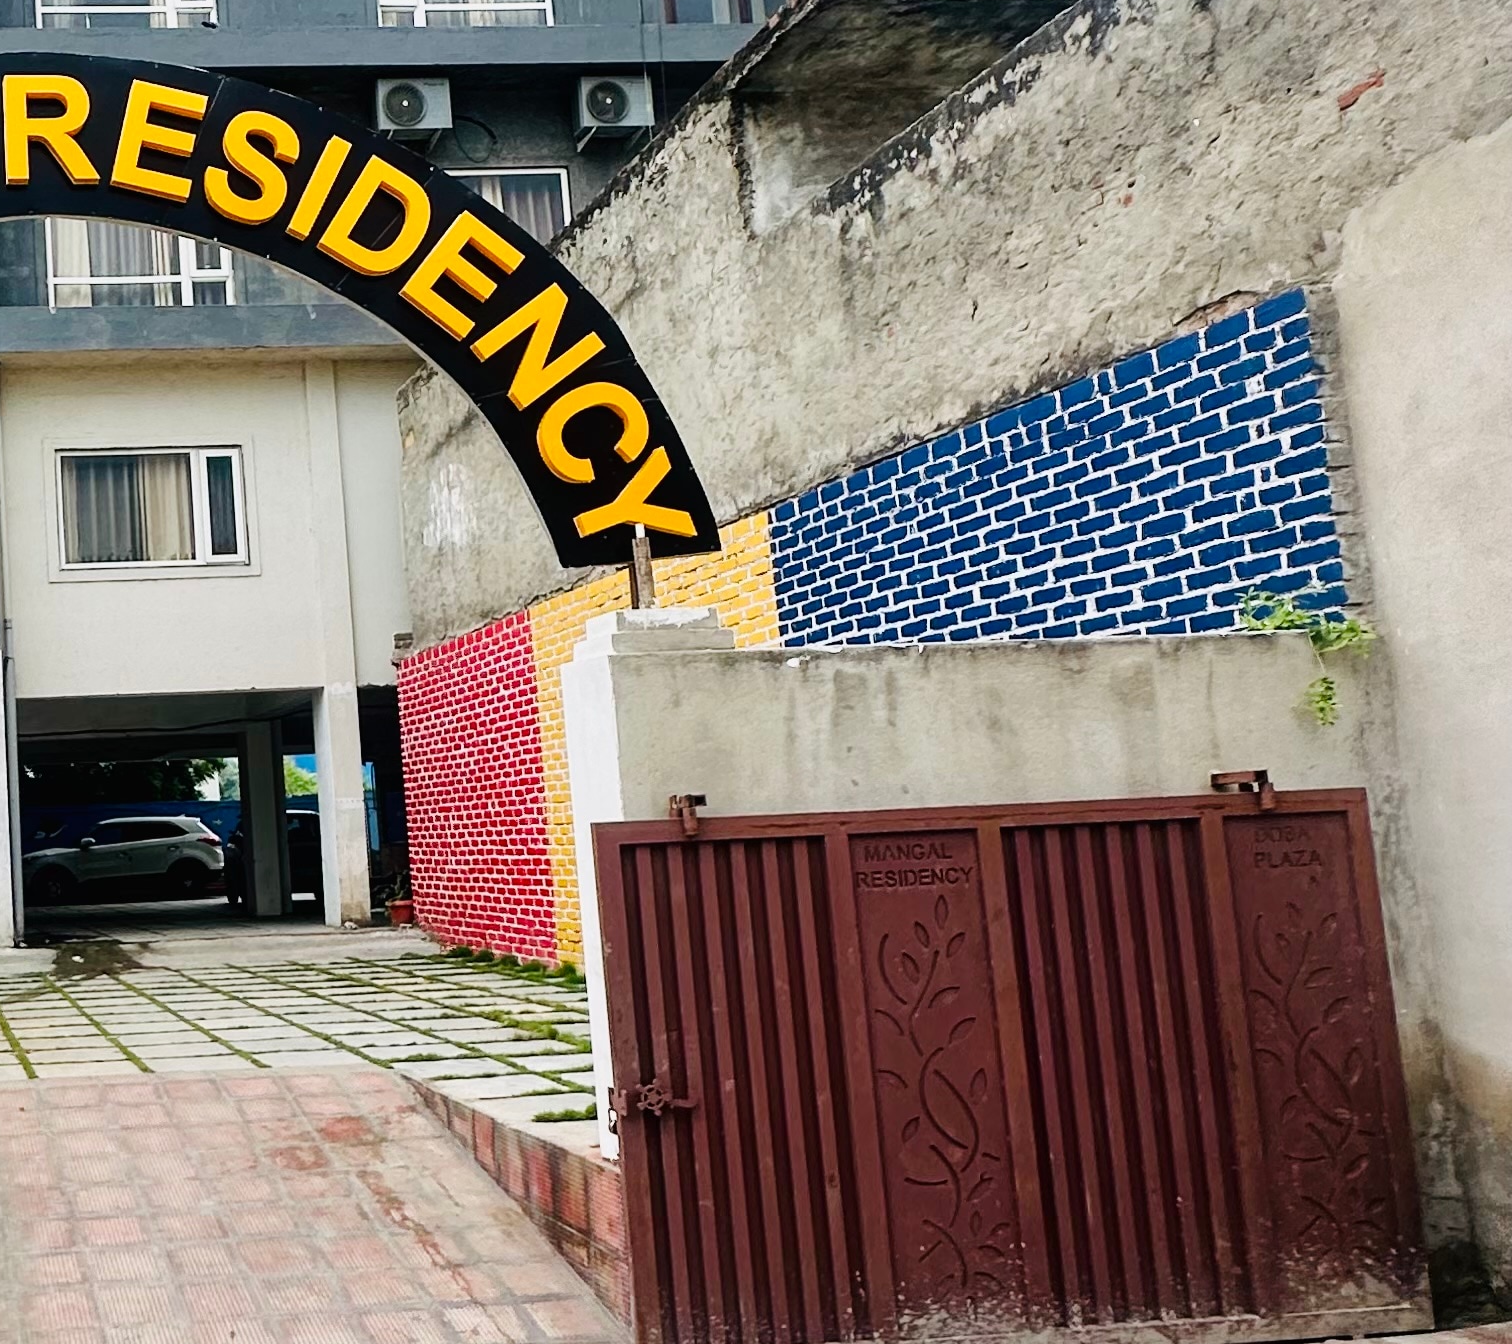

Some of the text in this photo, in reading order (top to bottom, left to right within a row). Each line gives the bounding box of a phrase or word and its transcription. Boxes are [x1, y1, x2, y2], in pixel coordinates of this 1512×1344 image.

[2, 74, 700, 541] RESIDENCY
[863, 842, 953, 862] MANGAL
[1255, 850, 1322, 869] PLAZA
[854, 866, 974, 889] RESIDENCY
